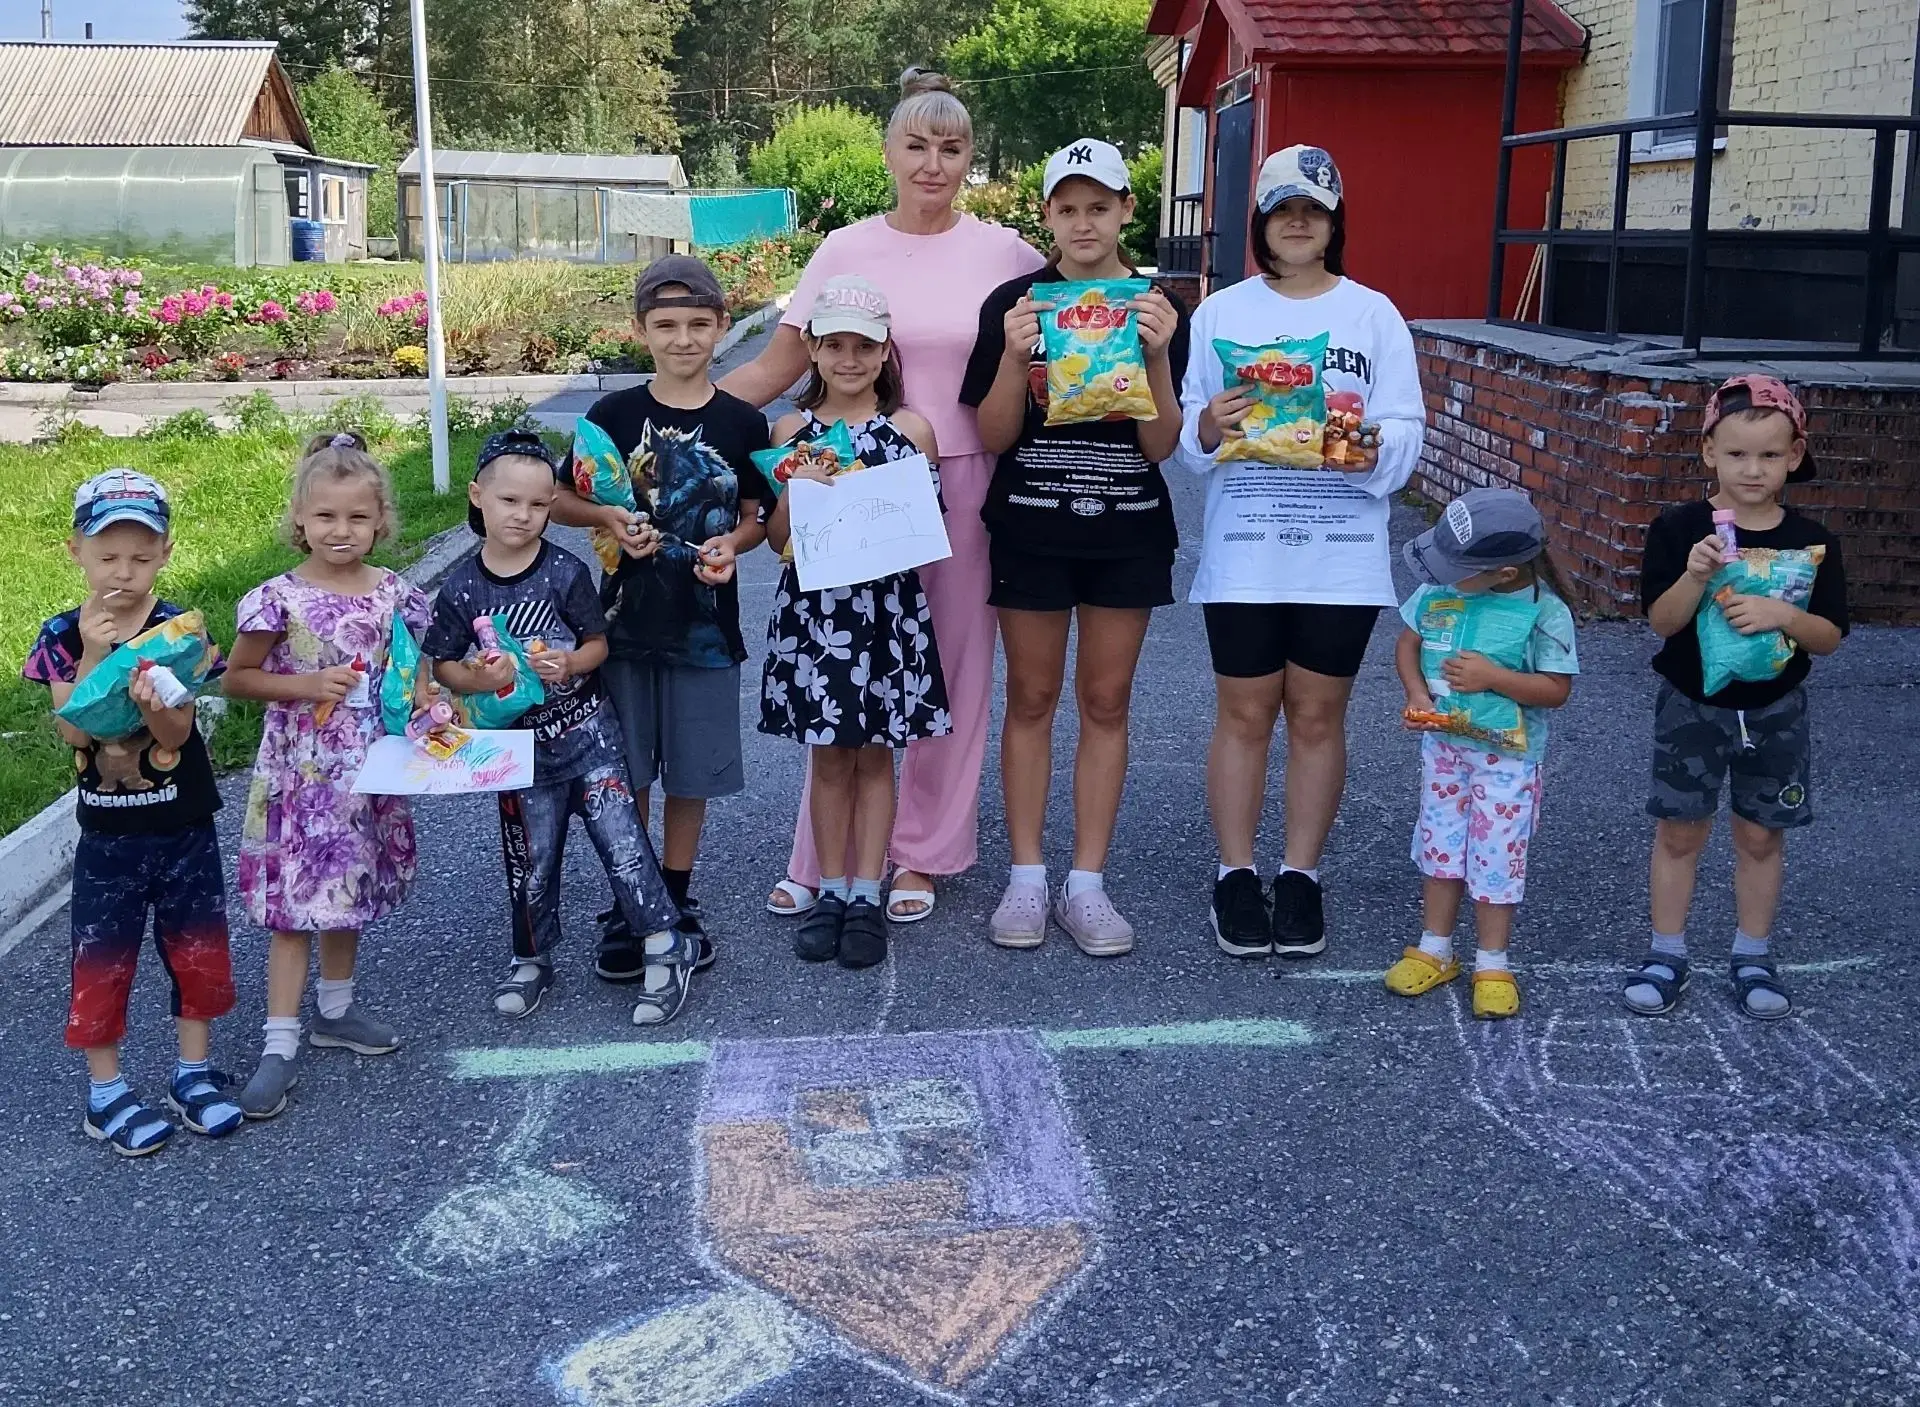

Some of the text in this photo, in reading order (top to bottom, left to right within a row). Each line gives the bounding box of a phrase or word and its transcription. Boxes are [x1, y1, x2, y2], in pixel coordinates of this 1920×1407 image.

[1067, 145, 1092, 164] NY
[824, 288, 881, 314] PINK
[1057, 304, 1129, 330] КУЗЯ
